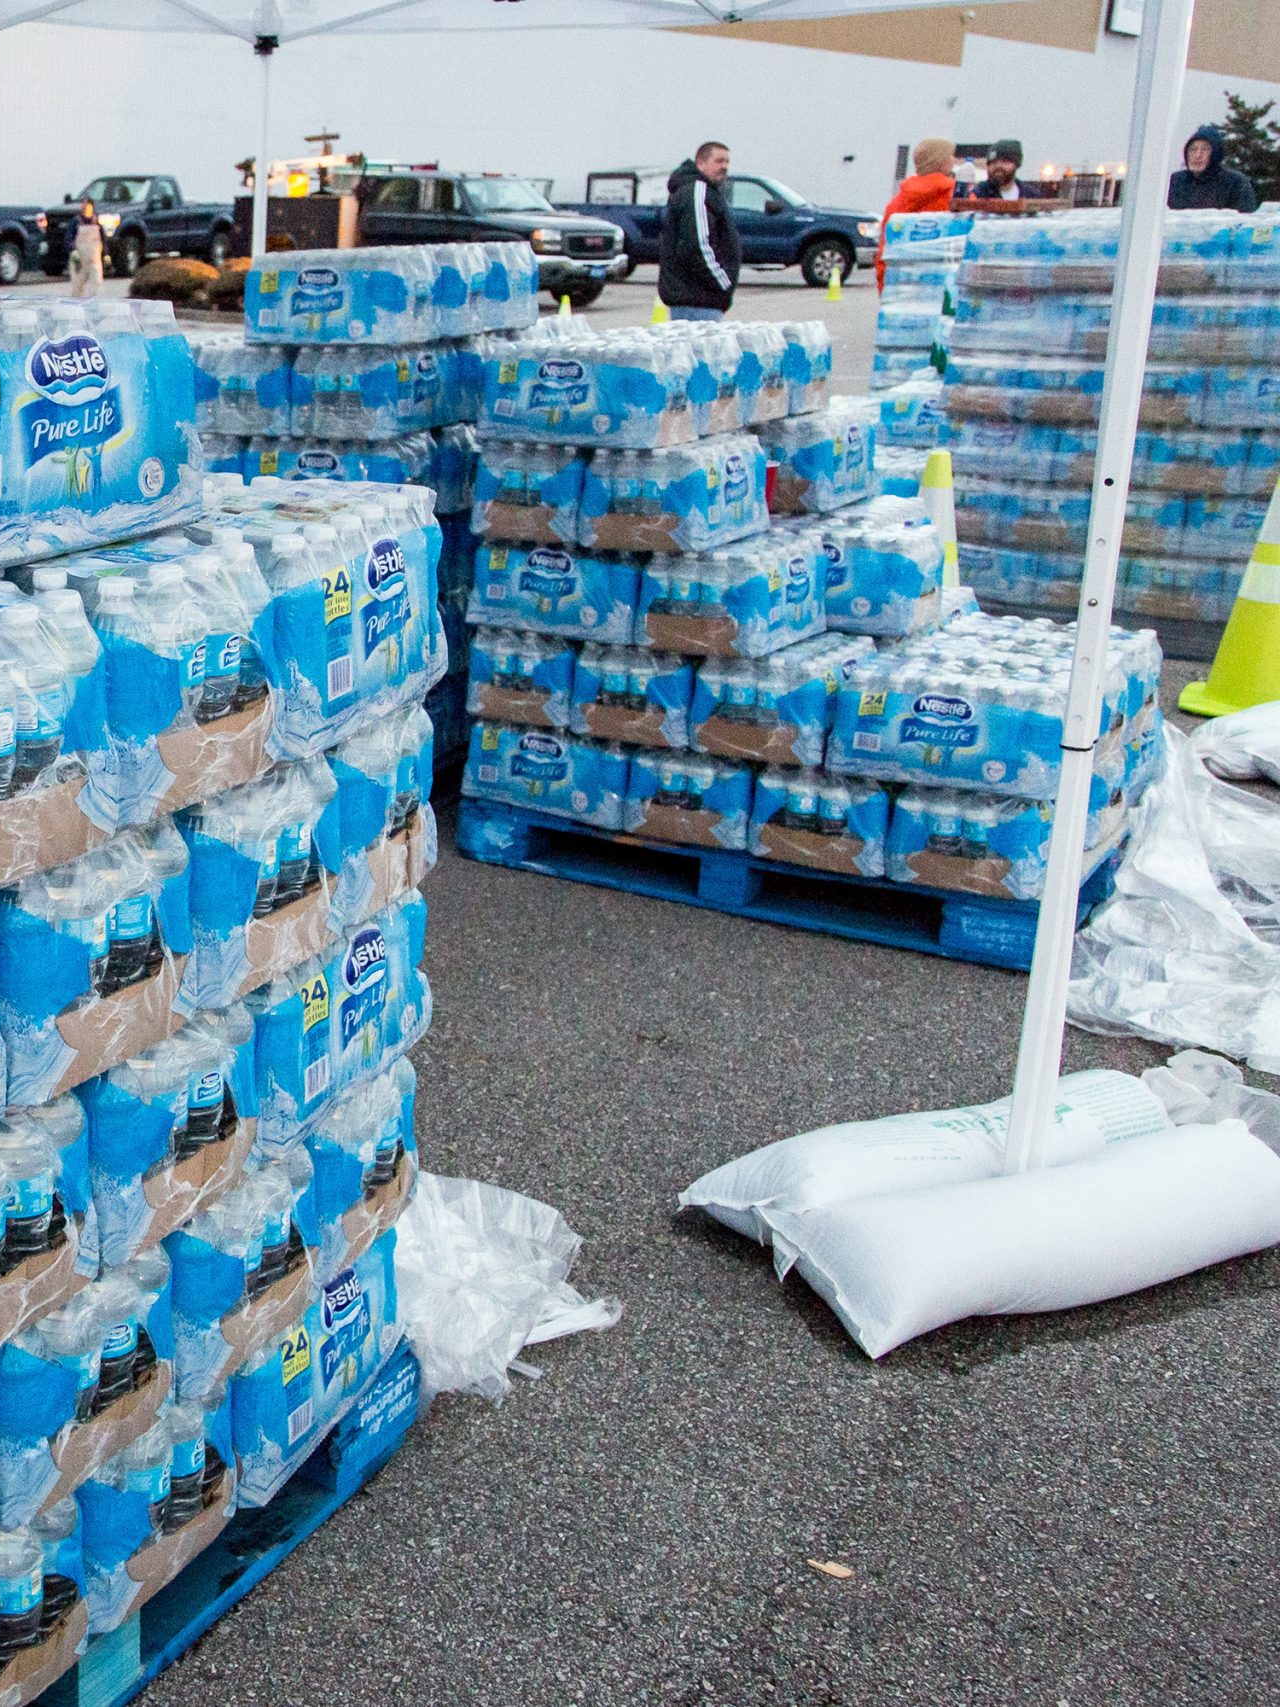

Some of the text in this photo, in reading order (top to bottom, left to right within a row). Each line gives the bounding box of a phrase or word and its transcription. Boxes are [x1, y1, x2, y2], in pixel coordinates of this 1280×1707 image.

[31, 400, 115, 448] Pure Life
[865, 694, 884, 706] 24
[920, 698, 967, 716] Nestlé
[905, 725, 970, 742] Pure Life
[282, 1331, 307, 1363] 24
